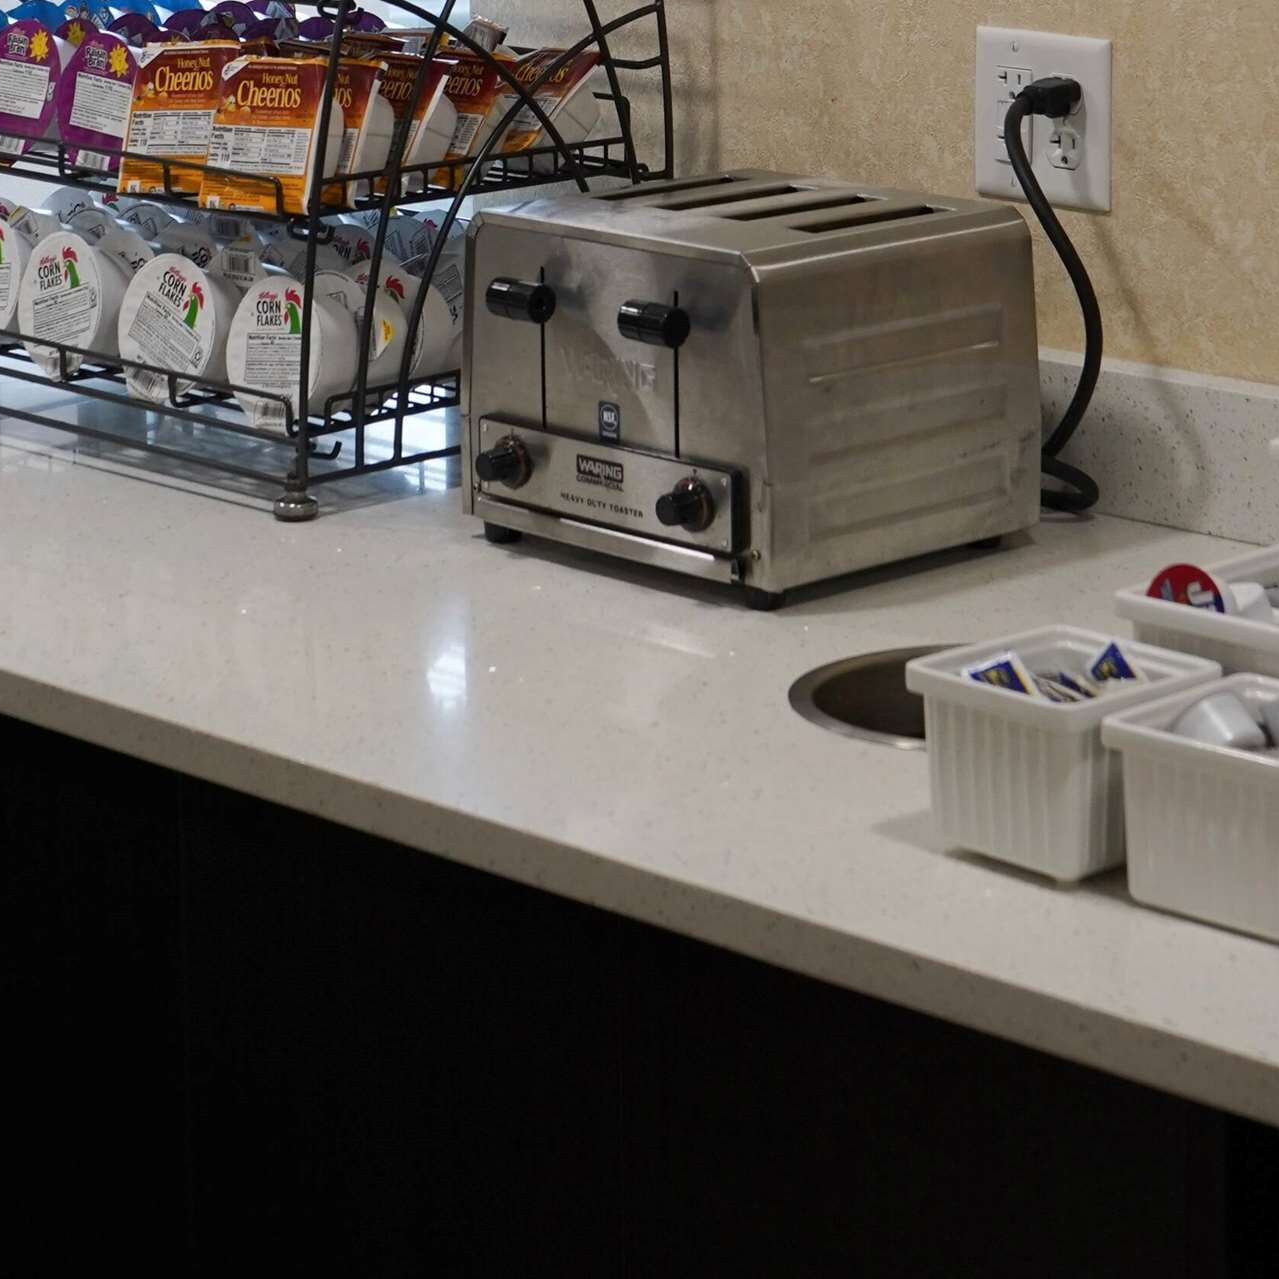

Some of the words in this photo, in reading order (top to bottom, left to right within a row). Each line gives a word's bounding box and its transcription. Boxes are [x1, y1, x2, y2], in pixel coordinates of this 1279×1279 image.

[177, 58, 199, 70] Honey
[199, 57, 211, 67] Nut
[155, 65, 214, 92] Cheerios
[262, 72, 284, 85] Honey
[285, 73, 298, 84] Nut
[237, 79, 302, 108] Cheerios
[38, 261, 61, 279] CORN
[39, 275, 62, 291] FLAKES
[163, 271, 187, 297] CORN
[158, 282, 183, 308] FLAKES
[256, 300, 282, 314] CORN
[256, 315, 283, 326] FLAKES
[578, 457, 622, 481] WARING
[560, 492, 584, 504] HEAVY
[609, 503, 644, 518] TOASTER
